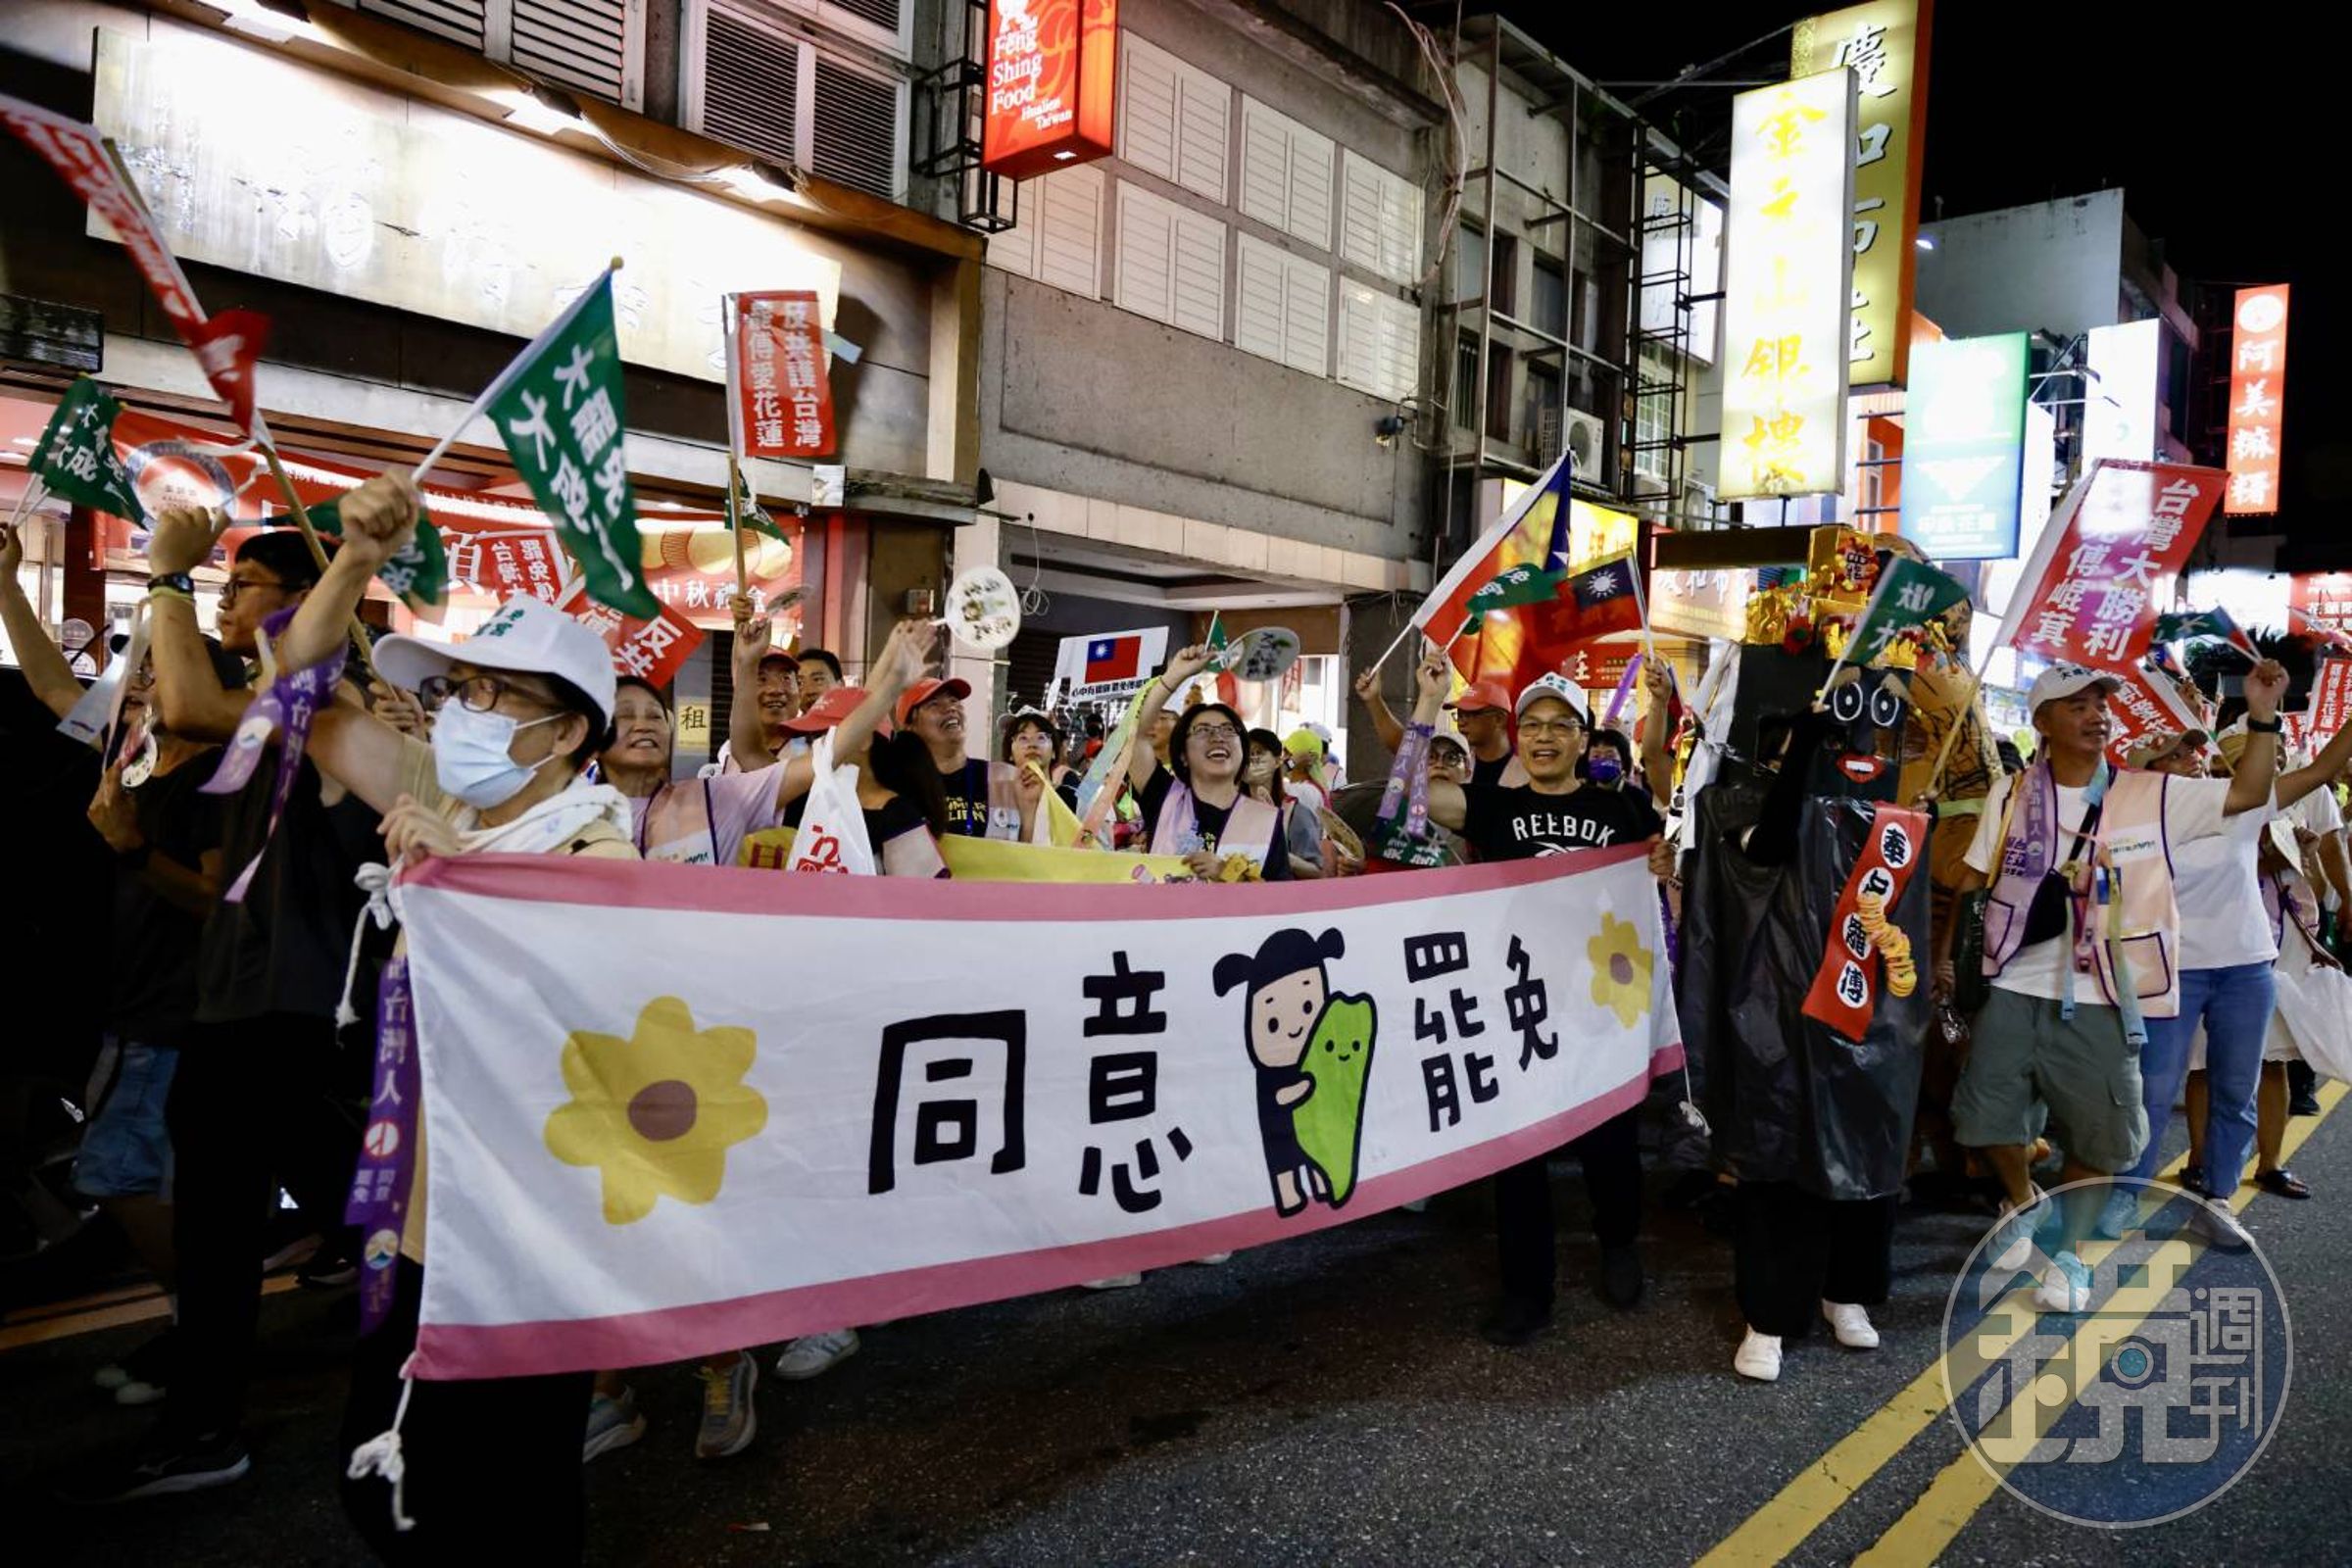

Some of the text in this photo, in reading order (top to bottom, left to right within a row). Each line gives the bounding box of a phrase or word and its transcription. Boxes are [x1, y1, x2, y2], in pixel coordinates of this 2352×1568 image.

[994, 29, 1037, 60] Feng
[993, 54, 1042, 87] Shing
[992, 77, 1036, 115] Food
[1021, 97, 1062, 121] Hualien
[1035, 110, 1073, 130] Taiwan
[745, 301, 784, 449] 罷傅愛花蓮
[783, 301, 822, 448] 反共護台灣
[2083, 478, 2199, 662] 台灣大勝利
[681, 706, 708, 730] 租
[1512, 812, 1616, 850] REEBOK
[868, 930, 1560, 1213] 同意 罷免
